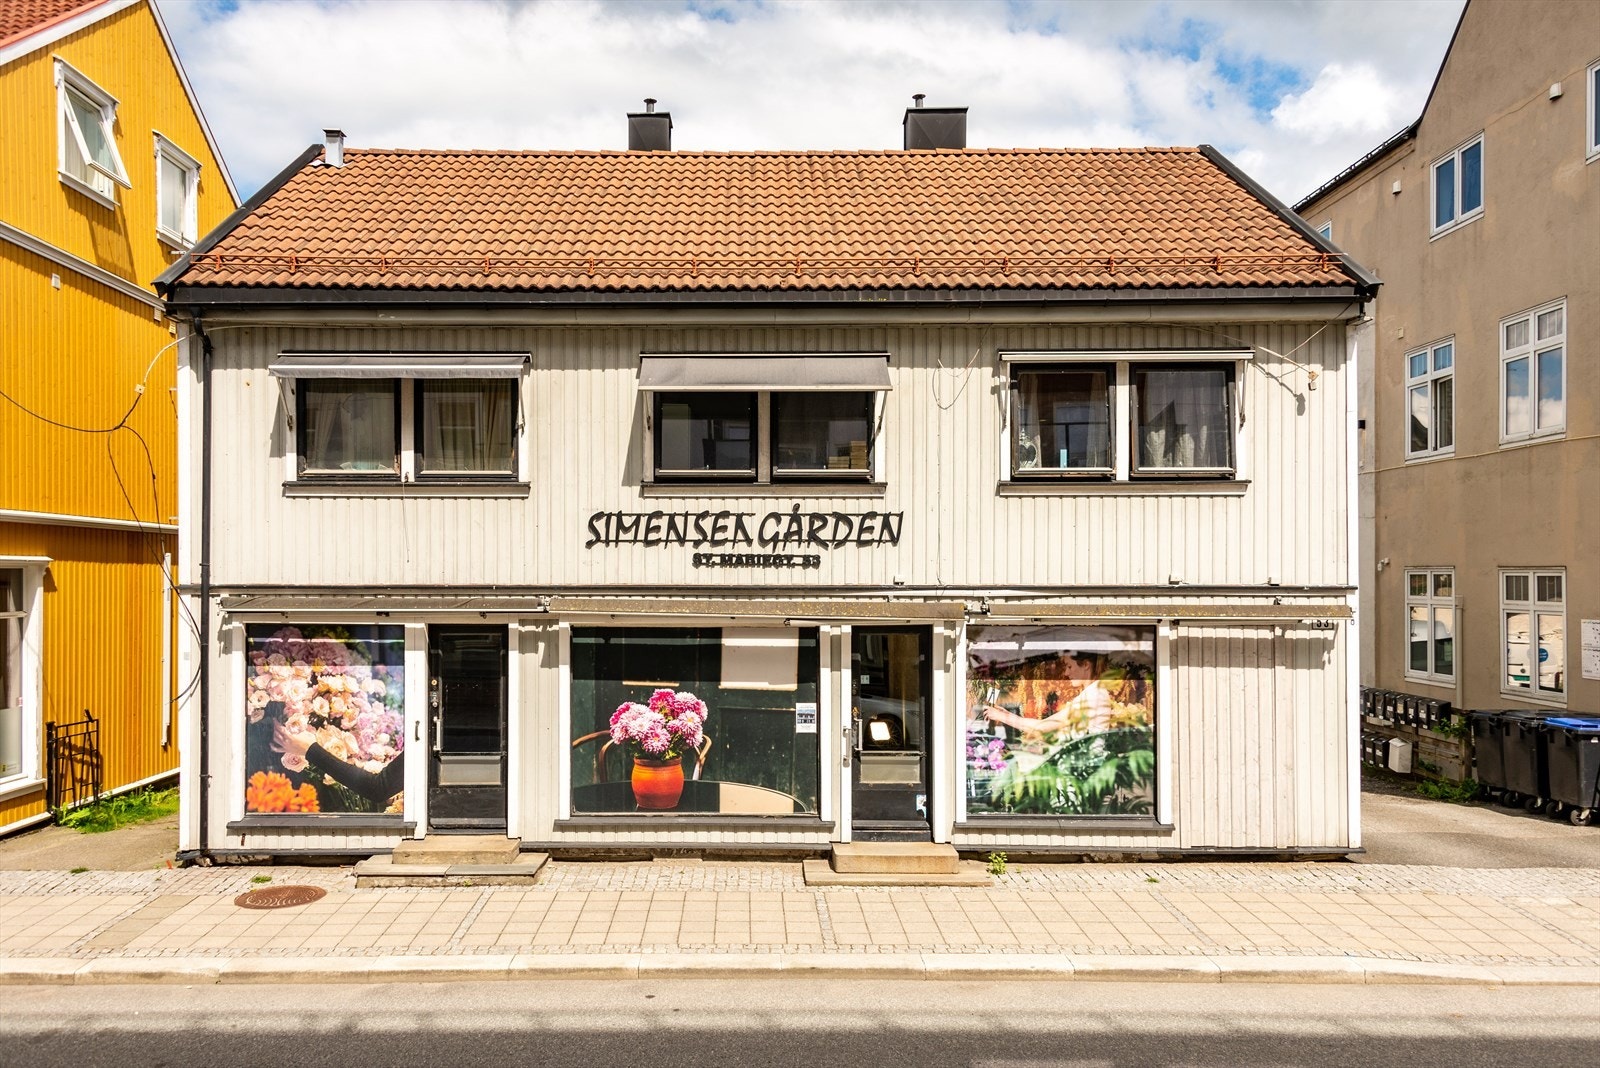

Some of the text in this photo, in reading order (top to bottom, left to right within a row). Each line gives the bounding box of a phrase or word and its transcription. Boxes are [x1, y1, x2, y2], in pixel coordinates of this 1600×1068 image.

[757, 503, 904, 552] GÅRDEN
[692, 553, 715, 568] ST.
[802, 554, 821, 569] 53
